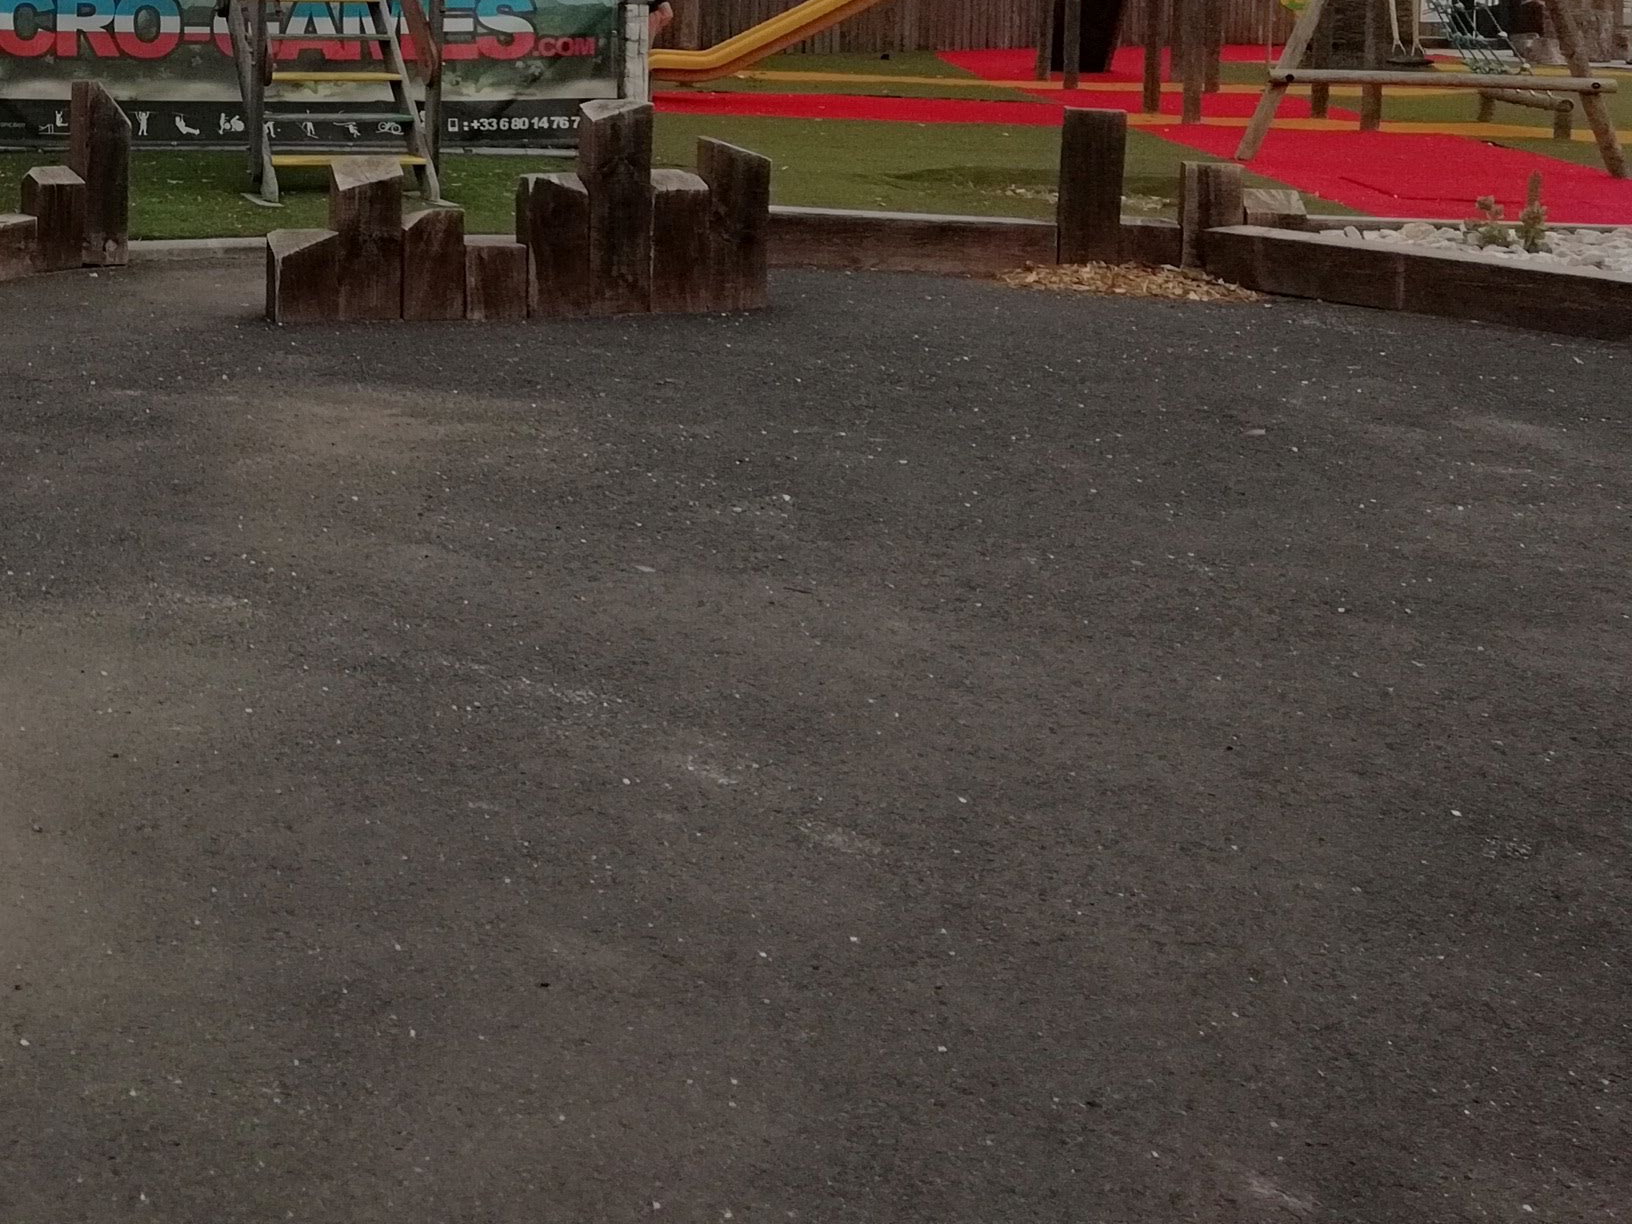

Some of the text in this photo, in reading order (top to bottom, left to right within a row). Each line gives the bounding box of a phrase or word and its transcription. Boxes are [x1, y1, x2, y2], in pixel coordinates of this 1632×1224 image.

[499, 117, 510, 130] 6
[510, 117, 529, 130] 80
[531, 116, 549, 129] 14
[550, 116, 570, 129] 76
[571, 116, 581, 129] 7
